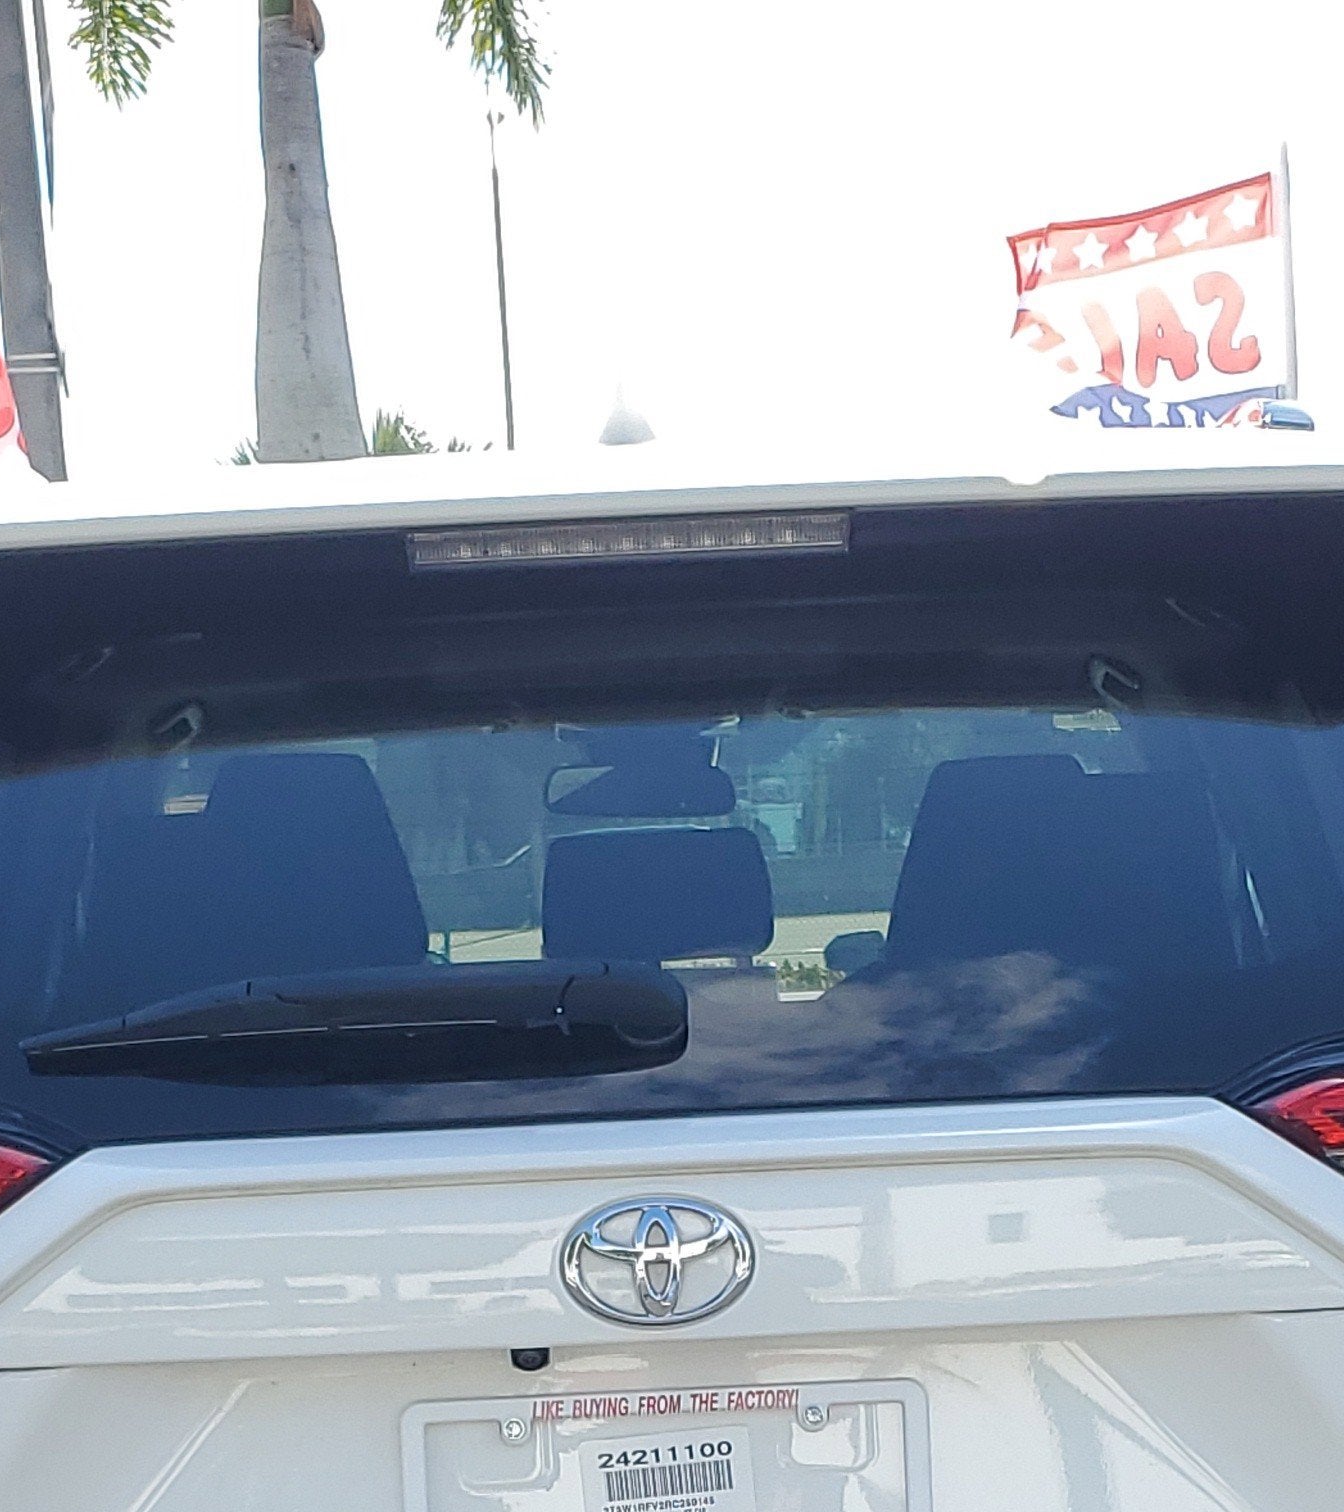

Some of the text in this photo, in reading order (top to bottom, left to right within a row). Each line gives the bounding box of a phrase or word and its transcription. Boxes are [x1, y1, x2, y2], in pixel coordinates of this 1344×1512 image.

[532, 1400, 565, 1421] LIKE
[572, 1397, 629, 1420] BUYING
[637, 1394, 682, 1416] FROM
[690, 1391, 719, 1413] THE
[597, 1440, 733, 1469] 24211100
